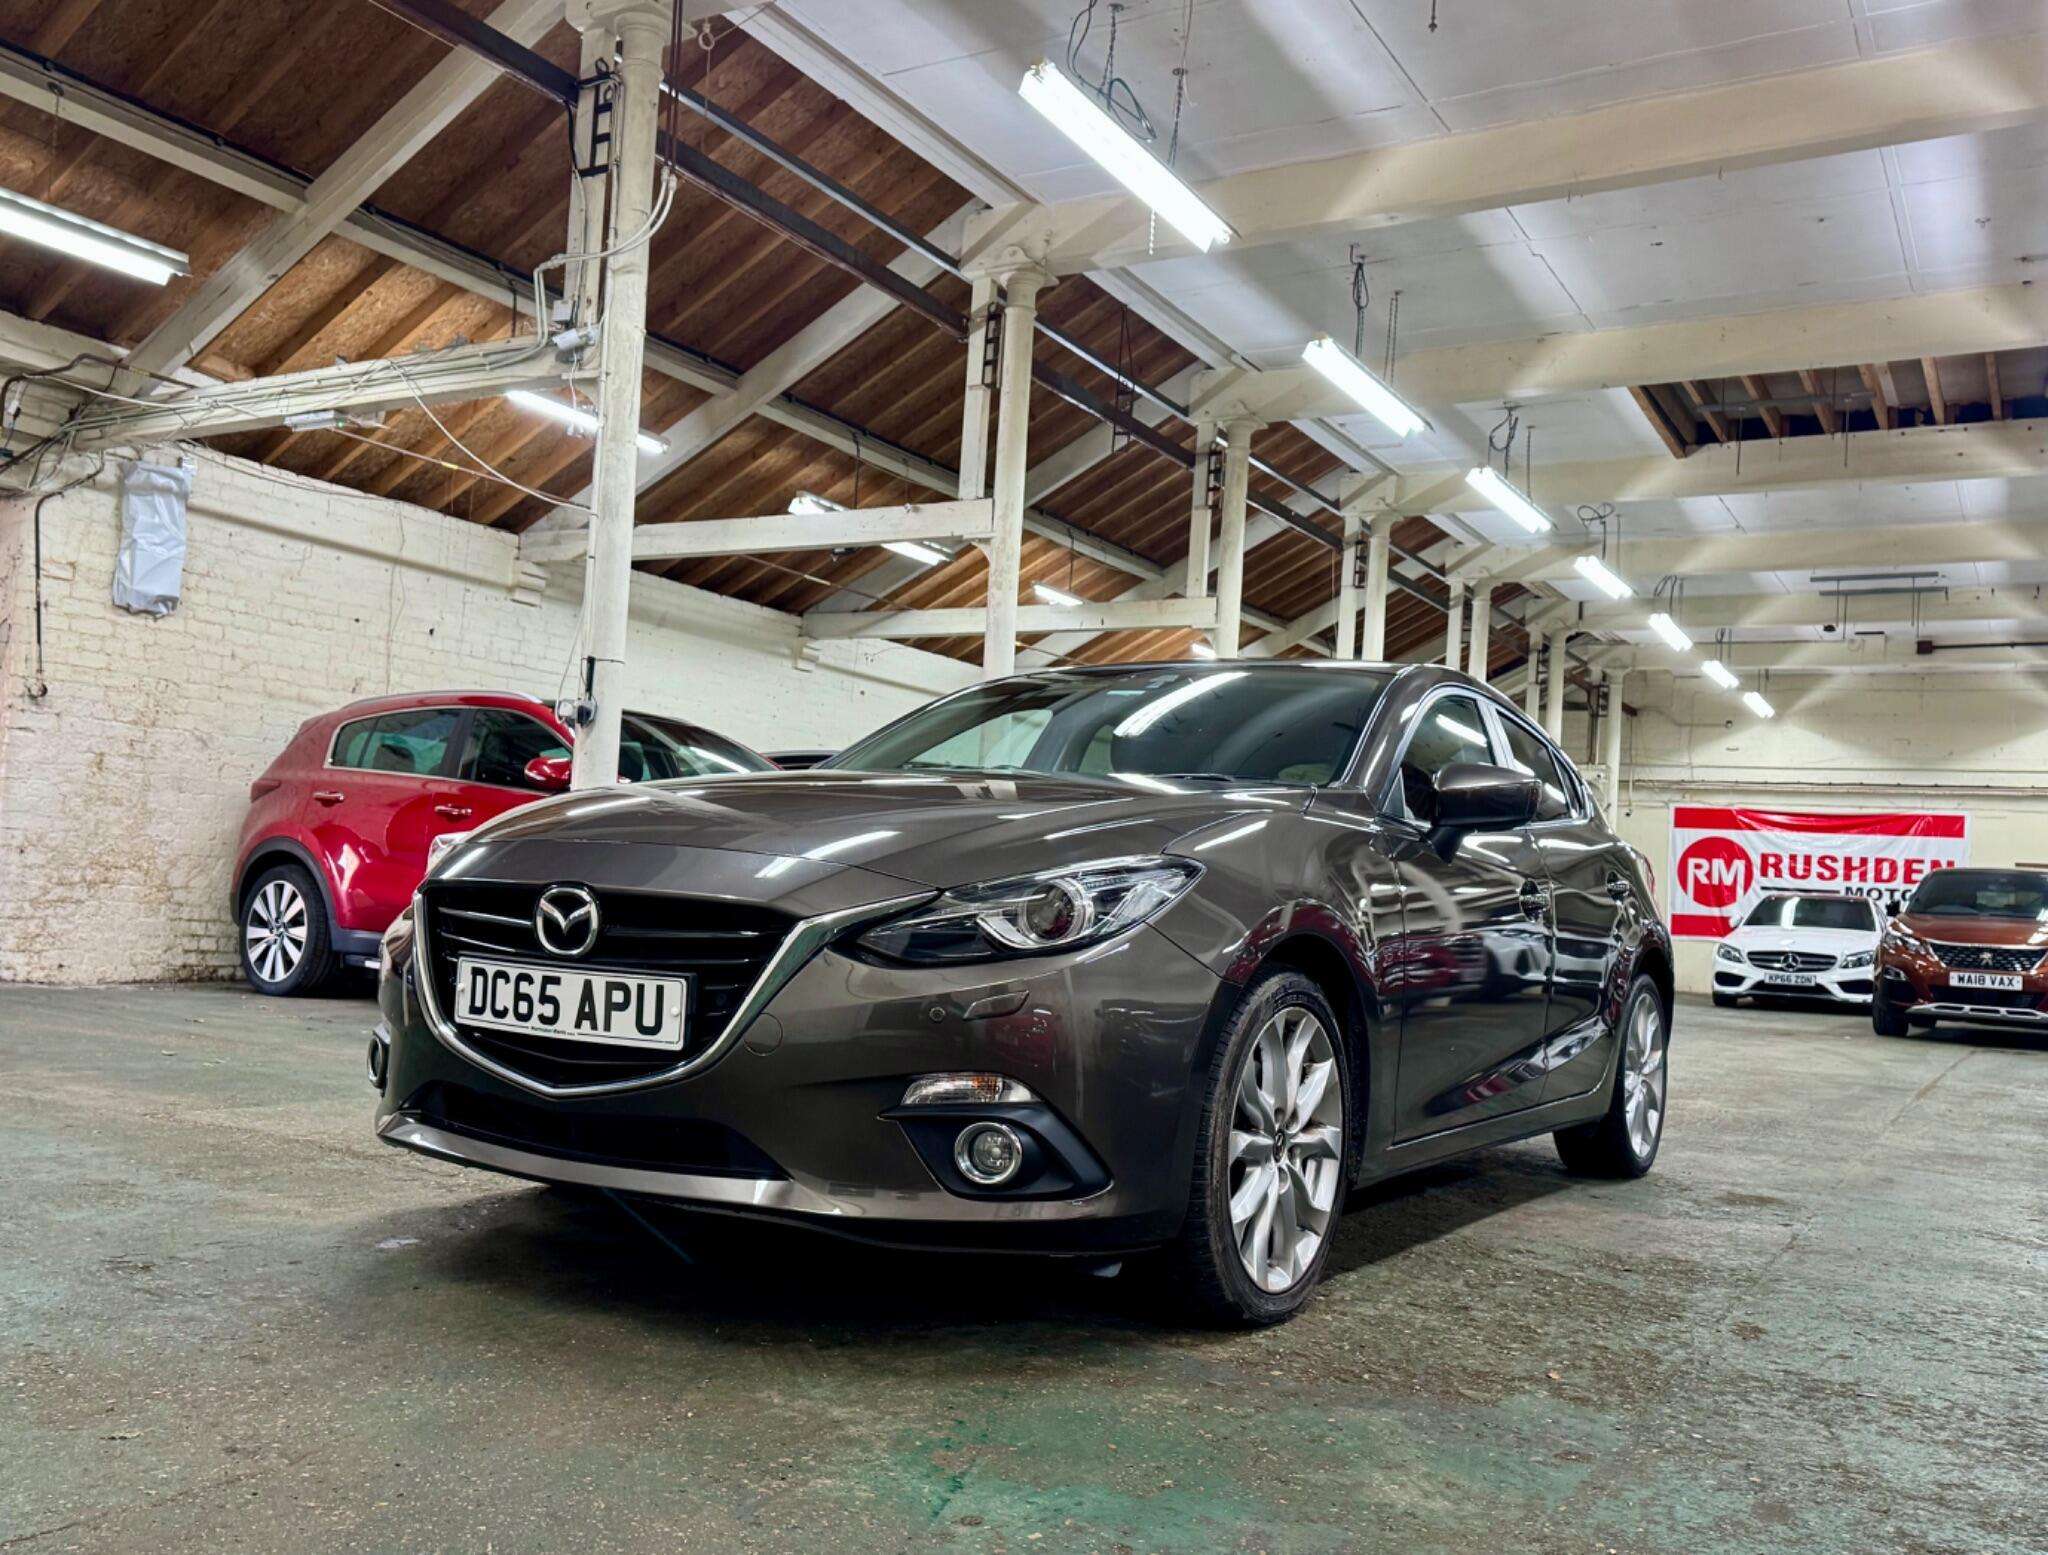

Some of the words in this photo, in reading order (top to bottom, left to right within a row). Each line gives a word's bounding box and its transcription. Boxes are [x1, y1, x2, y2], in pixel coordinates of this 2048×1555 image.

[1687, 858, 1745, 889] RM
[1845, 886, 1912, 901] MOTO
[1990, 976, 2014, 987] VAX
[469, 967, 561, 1026] DC65
[574, 979, 664, 1036] APU
